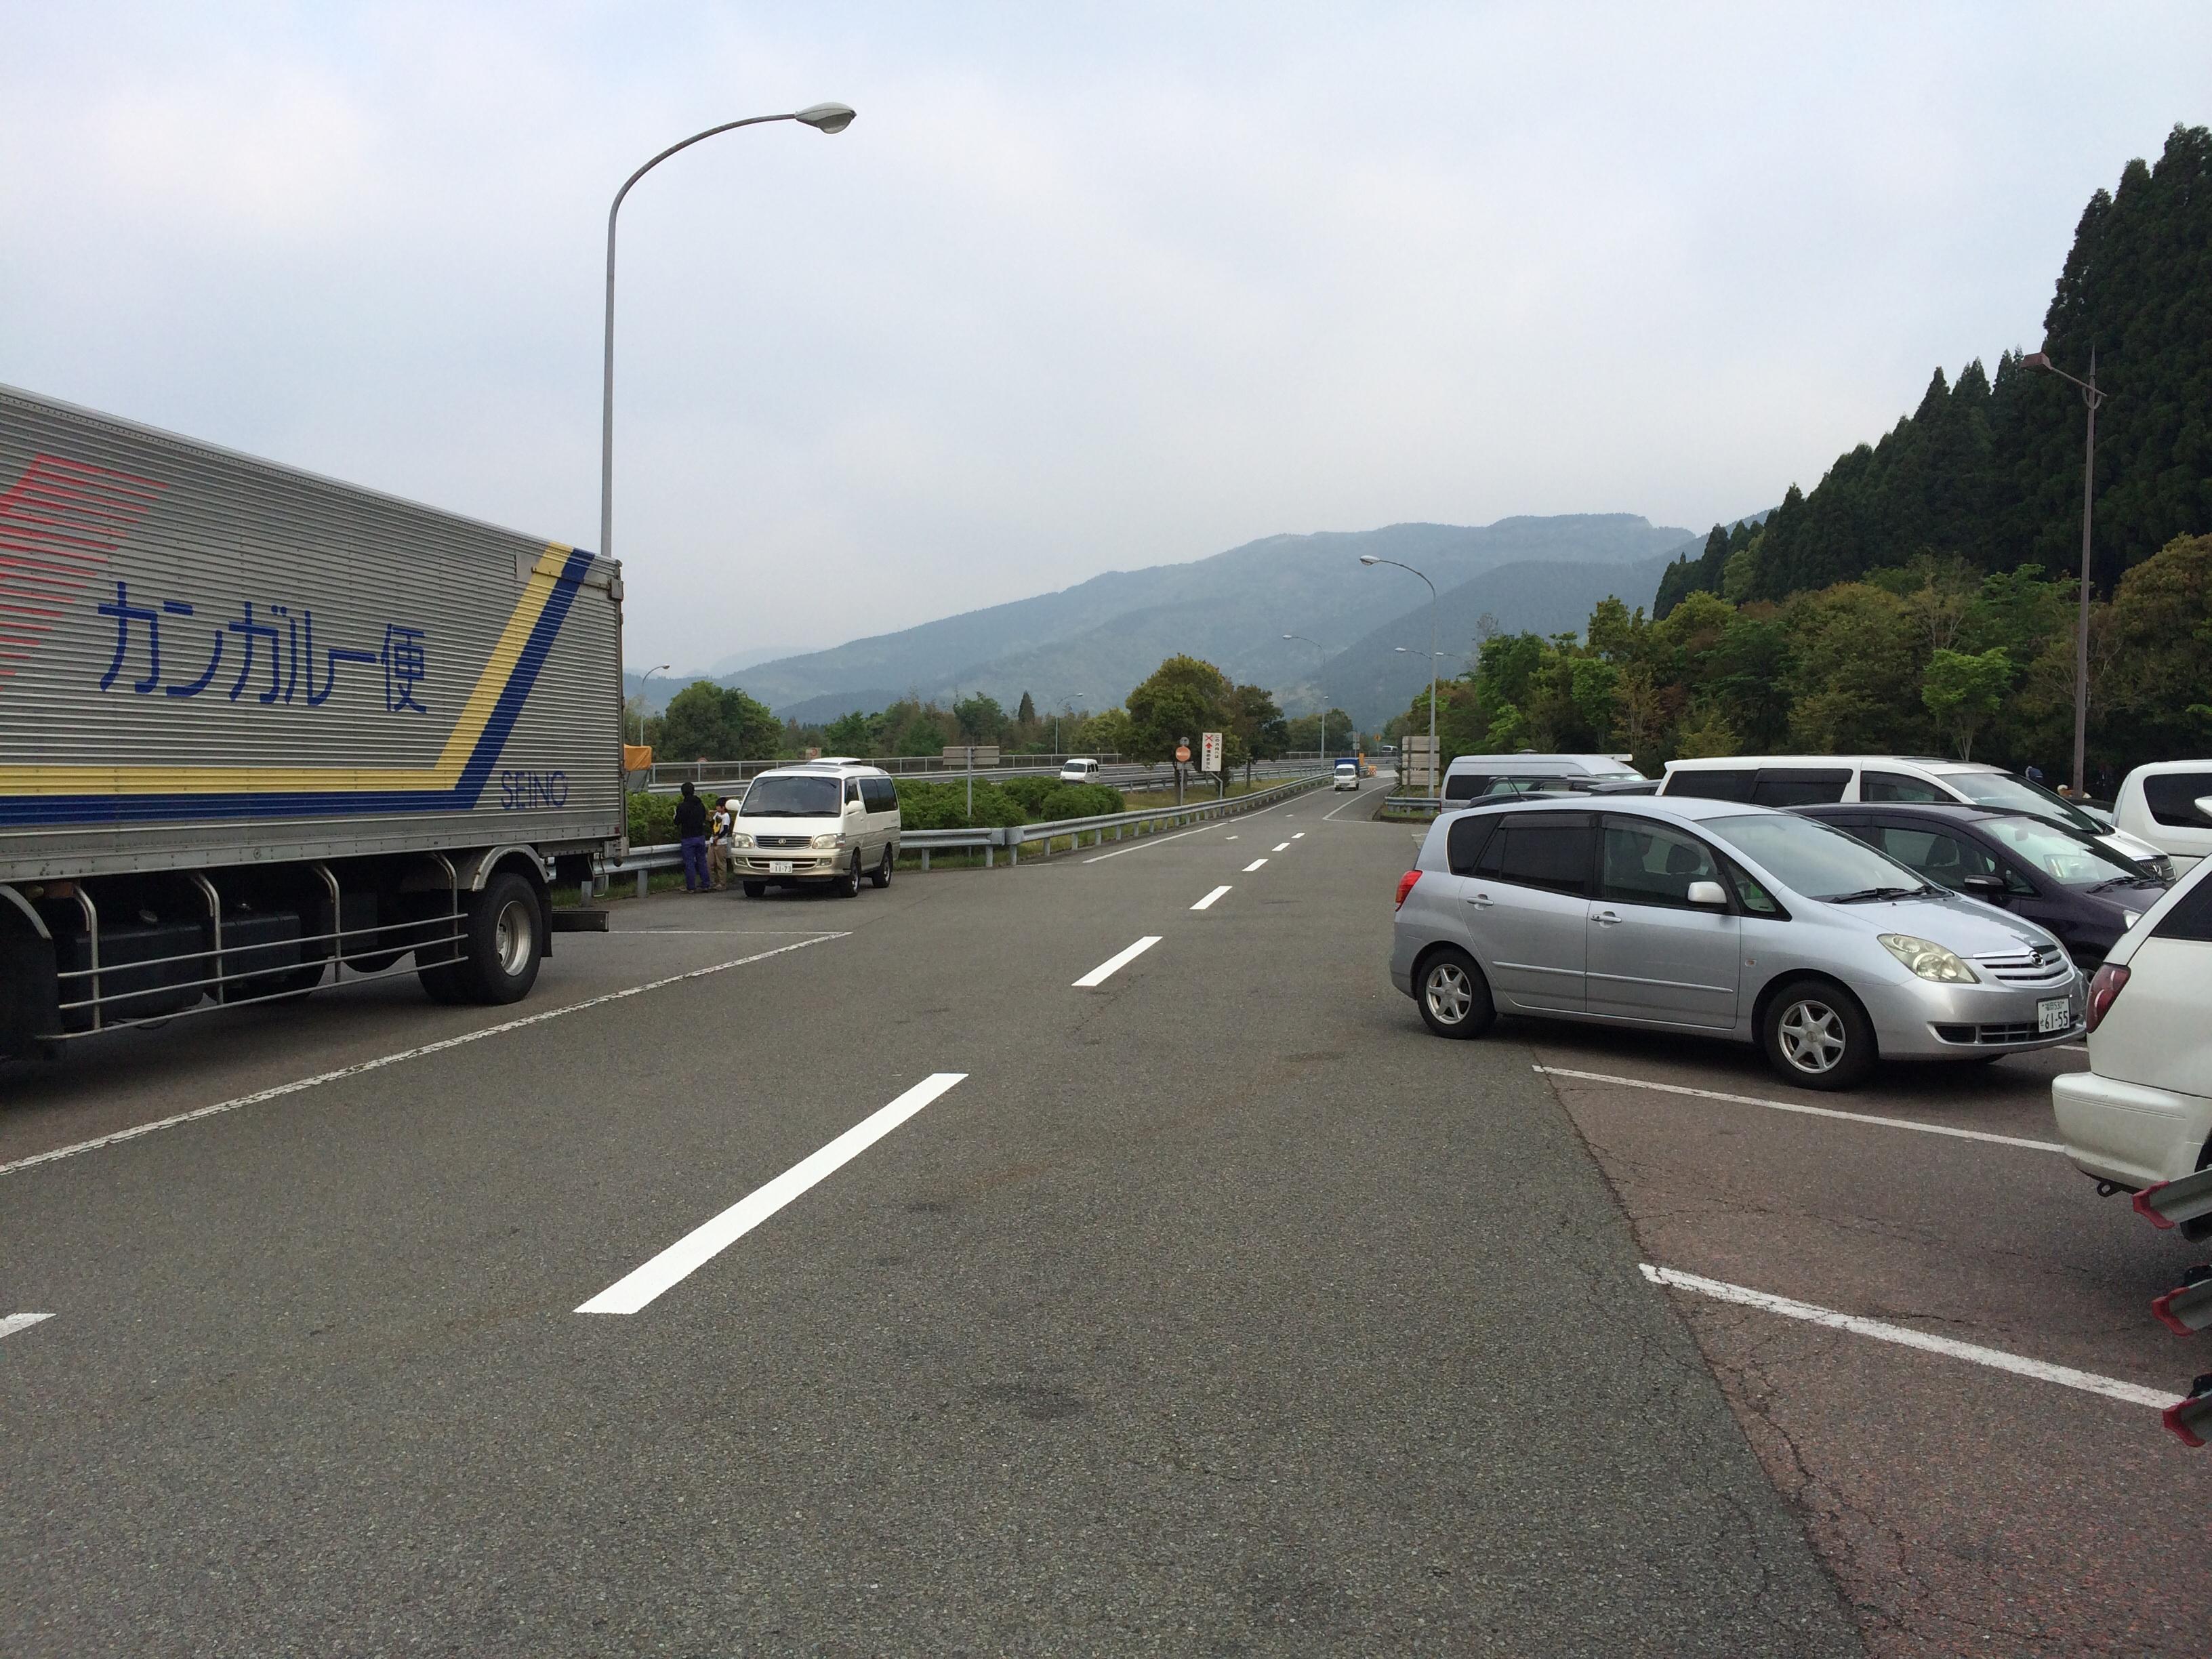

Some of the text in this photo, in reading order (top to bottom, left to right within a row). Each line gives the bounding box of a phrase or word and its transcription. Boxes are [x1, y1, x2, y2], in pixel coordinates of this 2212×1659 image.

[98, 581, 428, 714] カンガルー便
[501, 770, 568, 811] SEINO
[2045, 1010, 2068, 1029] 61-55
